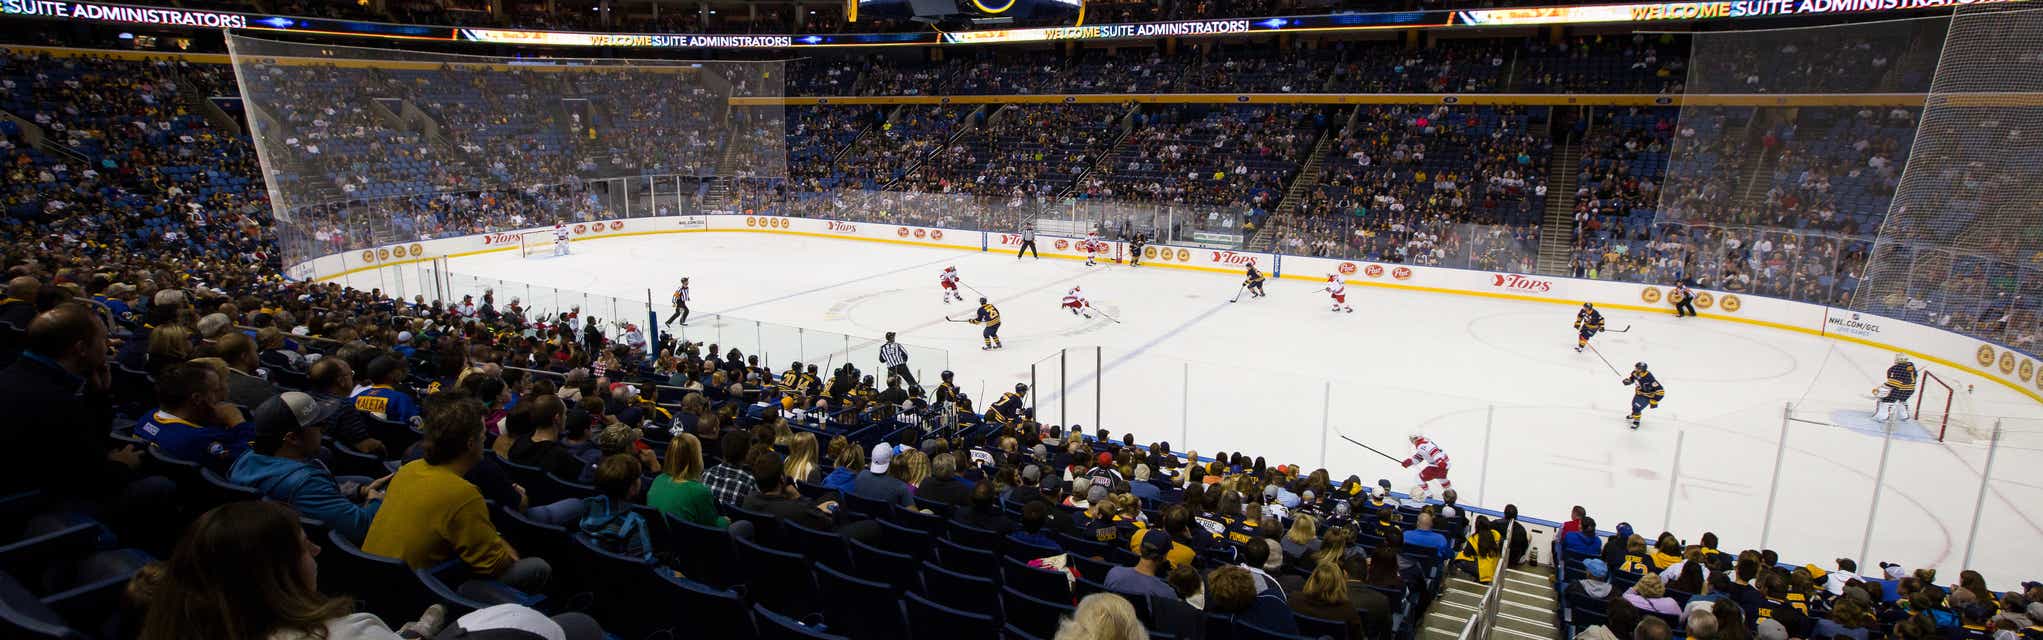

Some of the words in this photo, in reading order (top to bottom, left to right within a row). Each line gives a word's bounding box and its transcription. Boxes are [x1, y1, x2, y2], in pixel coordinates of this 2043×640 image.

[9, 0, 69, 17] SUITE
[73, 4, 247, 29] ADMINISTRATORS!
[1631, 2, 1731, 20] WELCOME
[1735, 0, 1794, 16] SUITE
[1044, 27, 1100, 40] WELCOME
[1103, 25, 1135, 38] SUITE
[1137, 20, 1249, 36] ADMINISTRATORS!
[591, 35, 652, 47] WELCOME
[655, 36, 688, 47] SUITE
[689, 36, 792, 48] ADMINISTRATORS!
